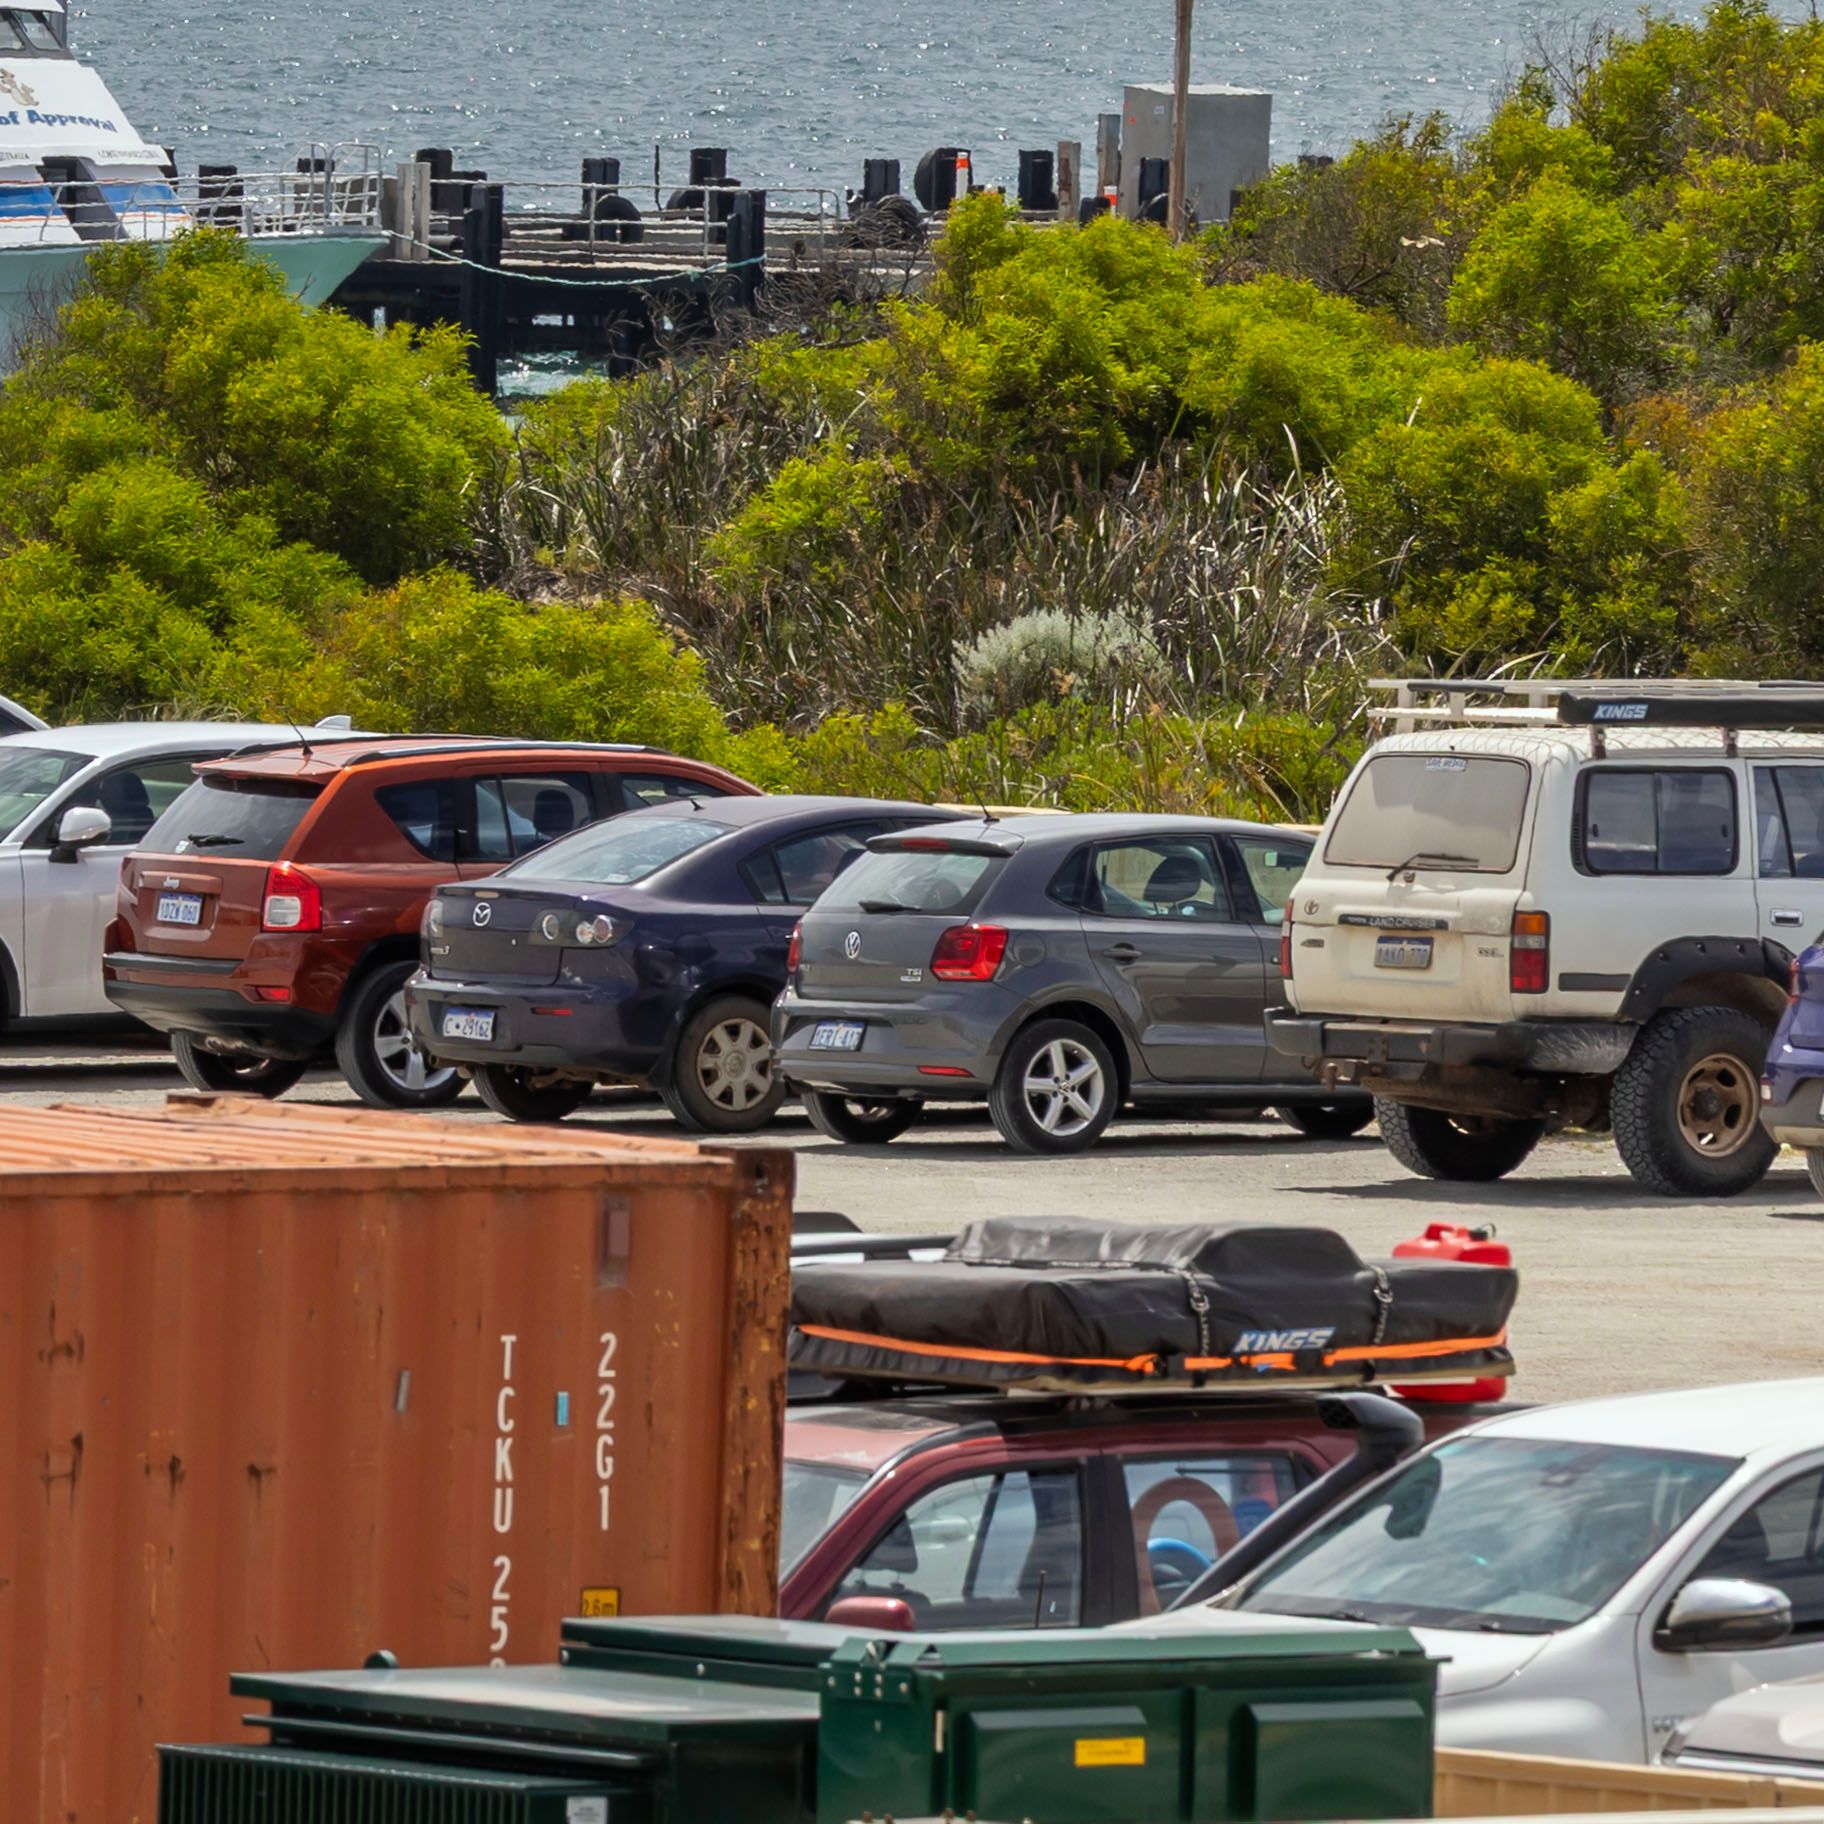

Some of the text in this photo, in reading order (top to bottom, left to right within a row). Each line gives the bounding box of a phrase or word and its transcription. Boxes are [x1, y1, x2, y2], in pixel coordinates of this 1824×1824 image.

[26, 109, 119, 134] Approval
[1593, 703, 1649, 719] KINGS
[1232, 1326, 1336, 1353] KINGS
[595, 1332, 618, 1531] 22G1
[489, 1334, 518, 1667] TCKU 25
